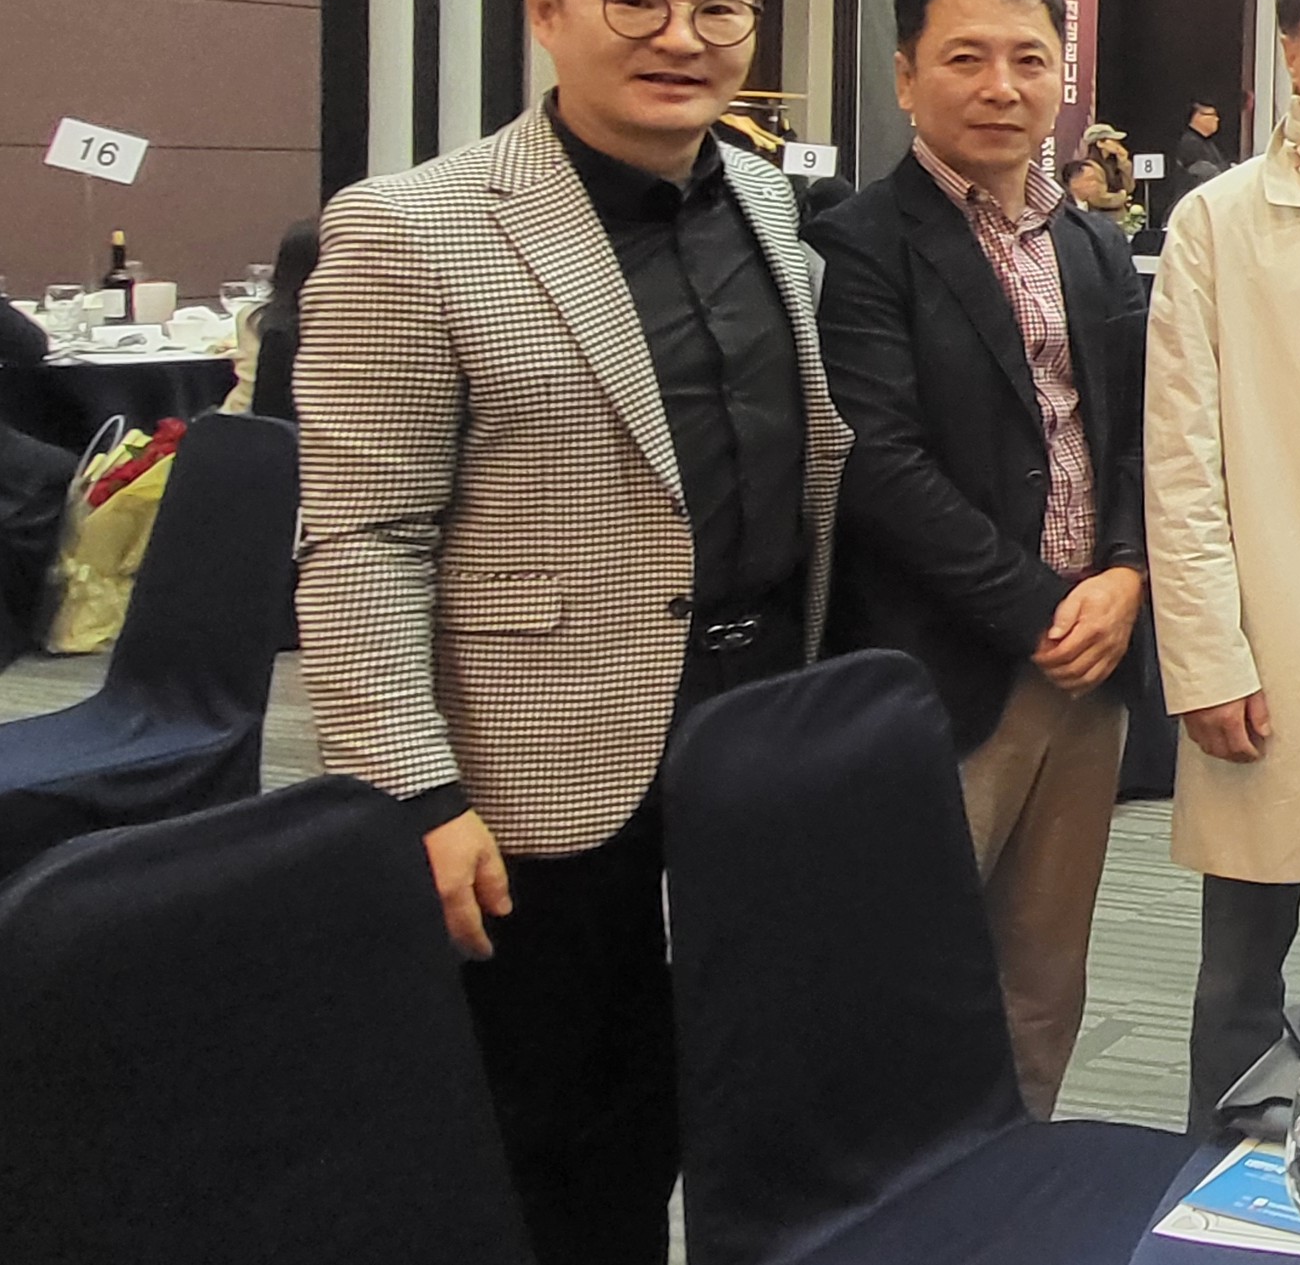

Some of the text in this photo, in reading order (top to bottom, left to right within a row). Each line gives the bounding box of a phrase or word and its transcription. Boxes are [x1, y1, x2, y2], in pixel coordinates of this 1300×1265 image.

[80, 137, 119, 166] 16
[803, 151, 816, 168] 9
[1144, 159, 1153, 173] 8
